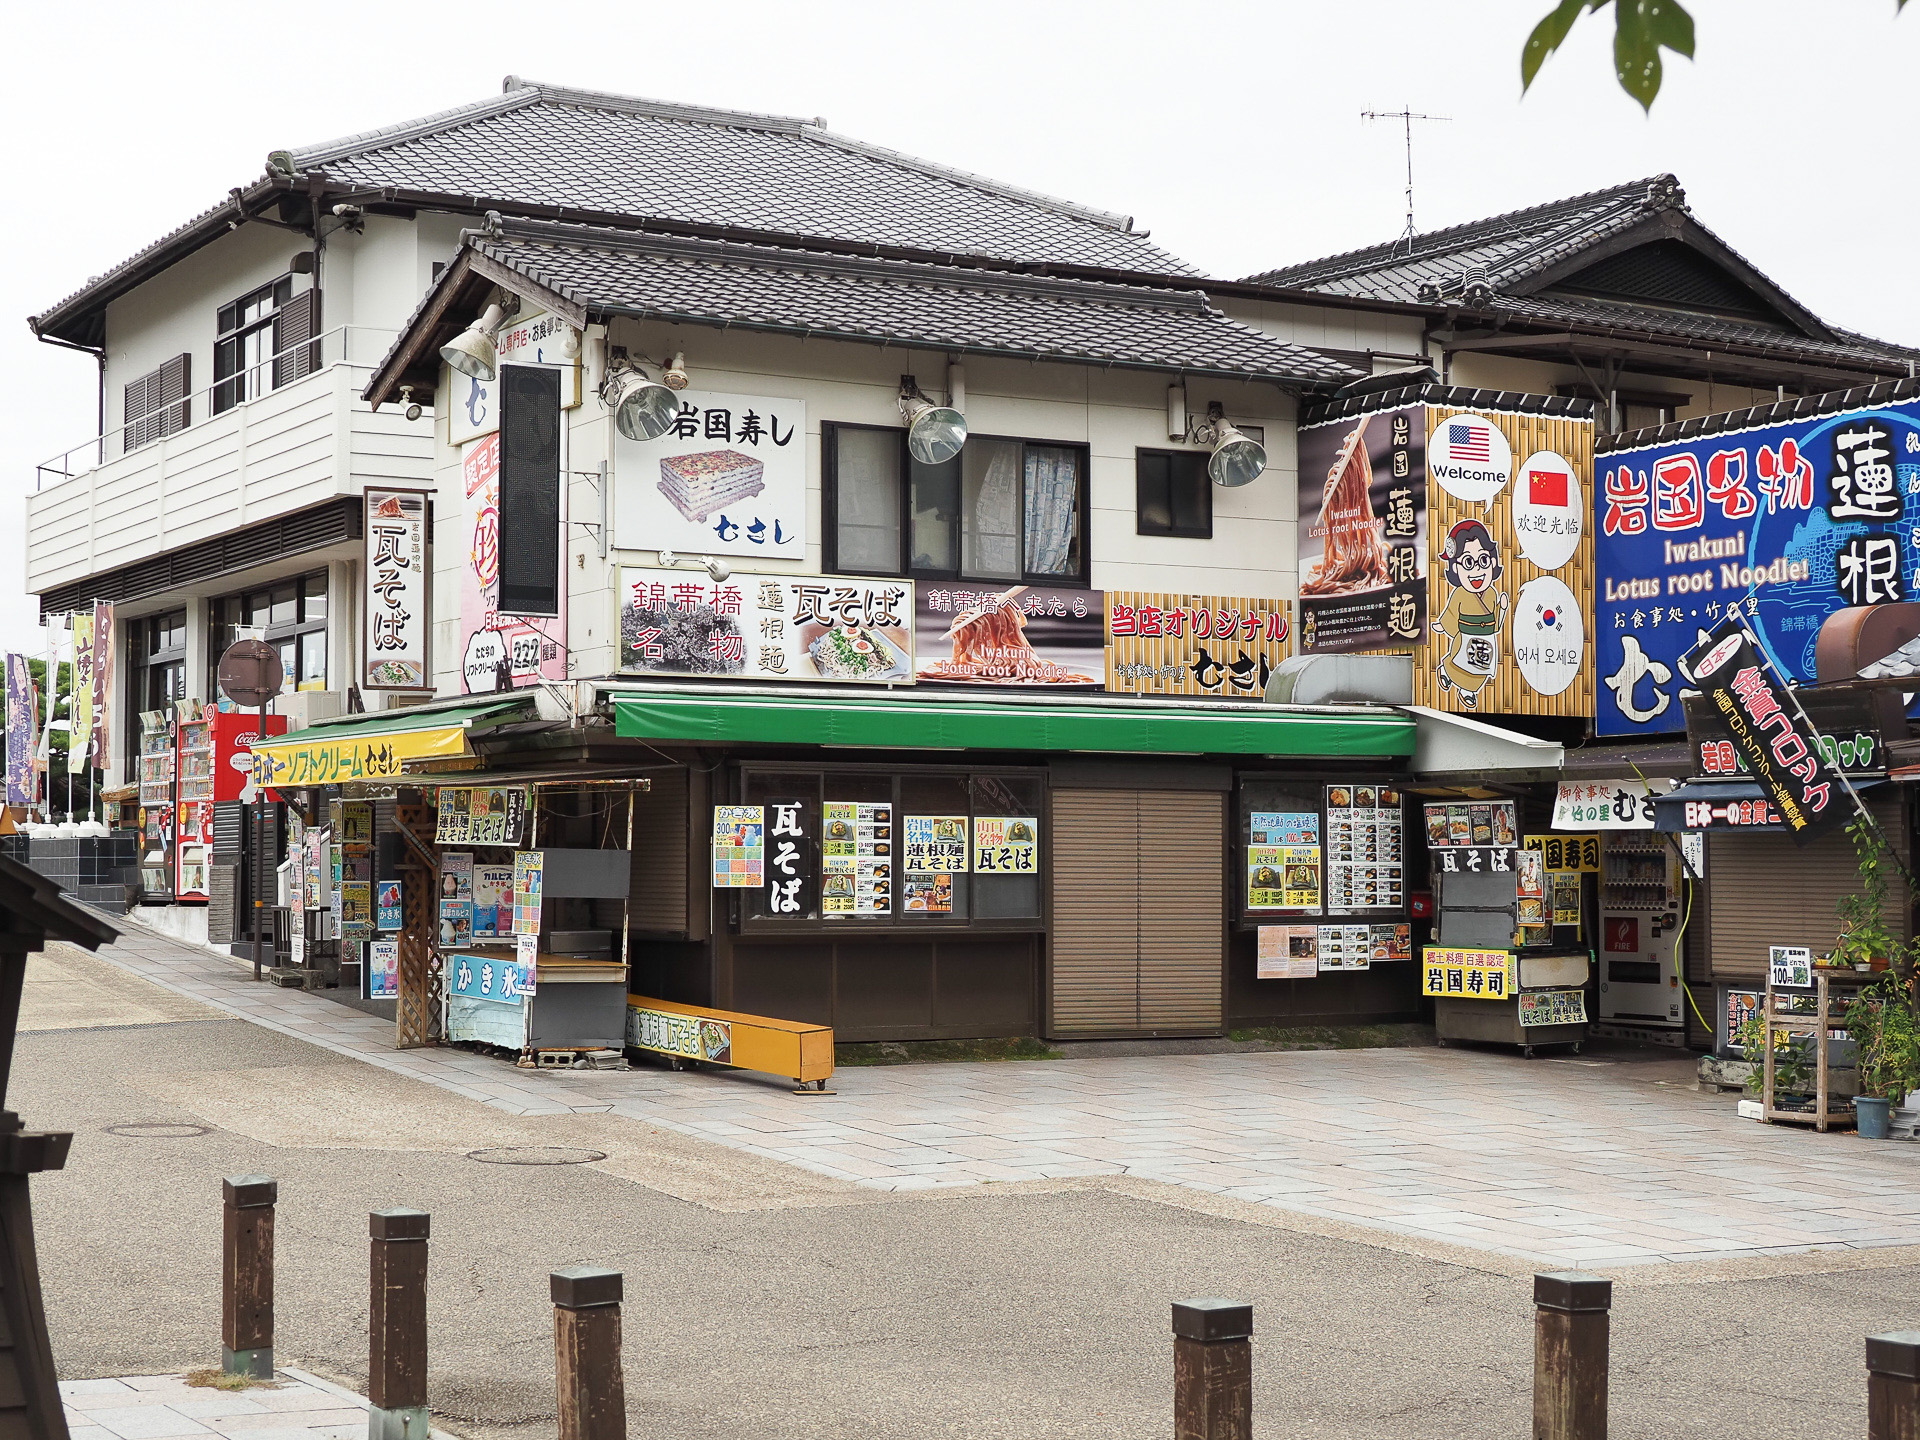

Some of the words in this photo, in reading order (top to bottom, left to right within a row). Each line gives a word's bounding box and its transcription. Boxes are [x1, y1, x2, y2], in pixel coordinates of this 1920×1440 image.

[668, 401, 795, 447] 岩国寿し
[1433, 463, 1507, 484] Welcome
[1603, 437, 1815, 536] 岩国名物
[1330, 505, 1362, 521] Iwakuni
[712, 514, 795, 545] むさし
[1308, 523, 1329, 538] Lotus
[1331, 522, 1350, 534] root
[1351, 516, 1385, 532] Noodle!
[1517, 515, 1579, 536] 欢迎光临
[1664, 531, 1746, 565] Iwakuni
[372, 524, 412, 652] 瓦そば
[1605, 576, 1661, 602] Lotus
[1667, 572, 1714, 596] root
[1720, 558, 1809, 591] Noodle!
[631, 580, 744, 617] 錦帯橋
[790, 583, 906, 628] 瓦そば
[927, 588, 1089, 619] 錦帯橋へ来たら
[1111, 604, 1291, 642] 当店オリジナル
[1780, 614, 1819, 632] 錦帯橋
[980, 645, 1032, 660] Iwakuni
[1517, 647, 1540, 666] 어서
[1544, 648, 1579, 666] 오세요
[1699, 637, 1739, 676] 日本一
[941, 659, 977, 677] Lotus
[982, 662, 1012, 676] root
[1016, 663, 1068, 679] Noodle!
[1731, 665, 1830, 812] 金賞コロッケ
[1559, 784, 1611, 802] 御食事処
[438, 815, 470, 829] 蓮根麺
[718, 806, 761, 819] かき氷
[1571, 804, 1610, 822] 竹の里
[470, 817, 504, 843] 瓦そば
[906, 818, 933, 831] 岩国
[977, 820, 1003, 833] 山口
[436, 829, 469, 842] 瓦そば
[906, 831, 933, 844] 名物
[977, 832, 1004, 846] 名物
[770, 800, 803, 914] 瓦そば
[906, 843, 965, 857] 蓮根麺
[977, 846, 1034, 871] 瓦そば
[906, 857, 965, 871] 瓦そば
[1440, 849, 1510, 873] 瓦そば
[484, 872, 513, 881] カルピス
[1614, 942, 1631, 950] FIRE
[457, 960, 518, 998] かき氷
[1427, 968, 1504, 996] 岩国寿司
[1773, 967, 1793, 985] 100円
[1523, 1009, 1551, 1024] 瓦そば
